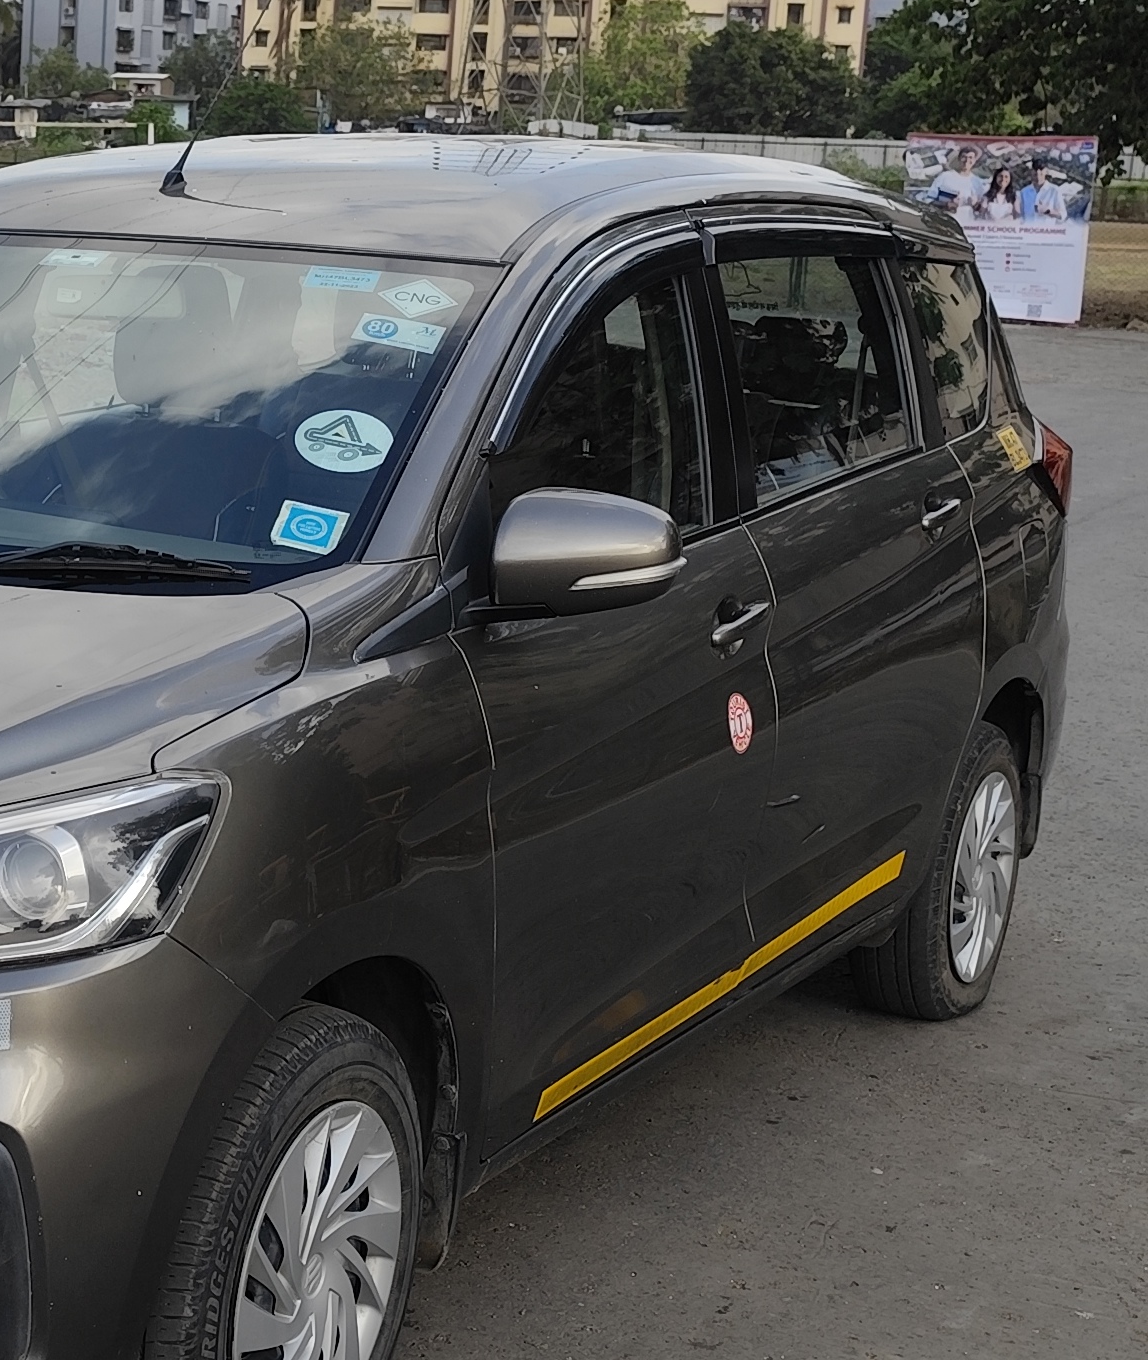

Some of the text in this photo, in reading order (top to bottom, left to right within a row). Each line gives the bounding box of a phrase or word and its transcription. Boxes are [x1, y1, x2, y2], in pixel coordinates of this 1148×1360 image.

[988, 226, 1016, 234] SCHOOL
[1019, 227, 1066, 236] PROGRAMME
[394, 291, 441, 305] CNG
[367, 320, 395, 335] 80
[737, 713, 743, 734] T
